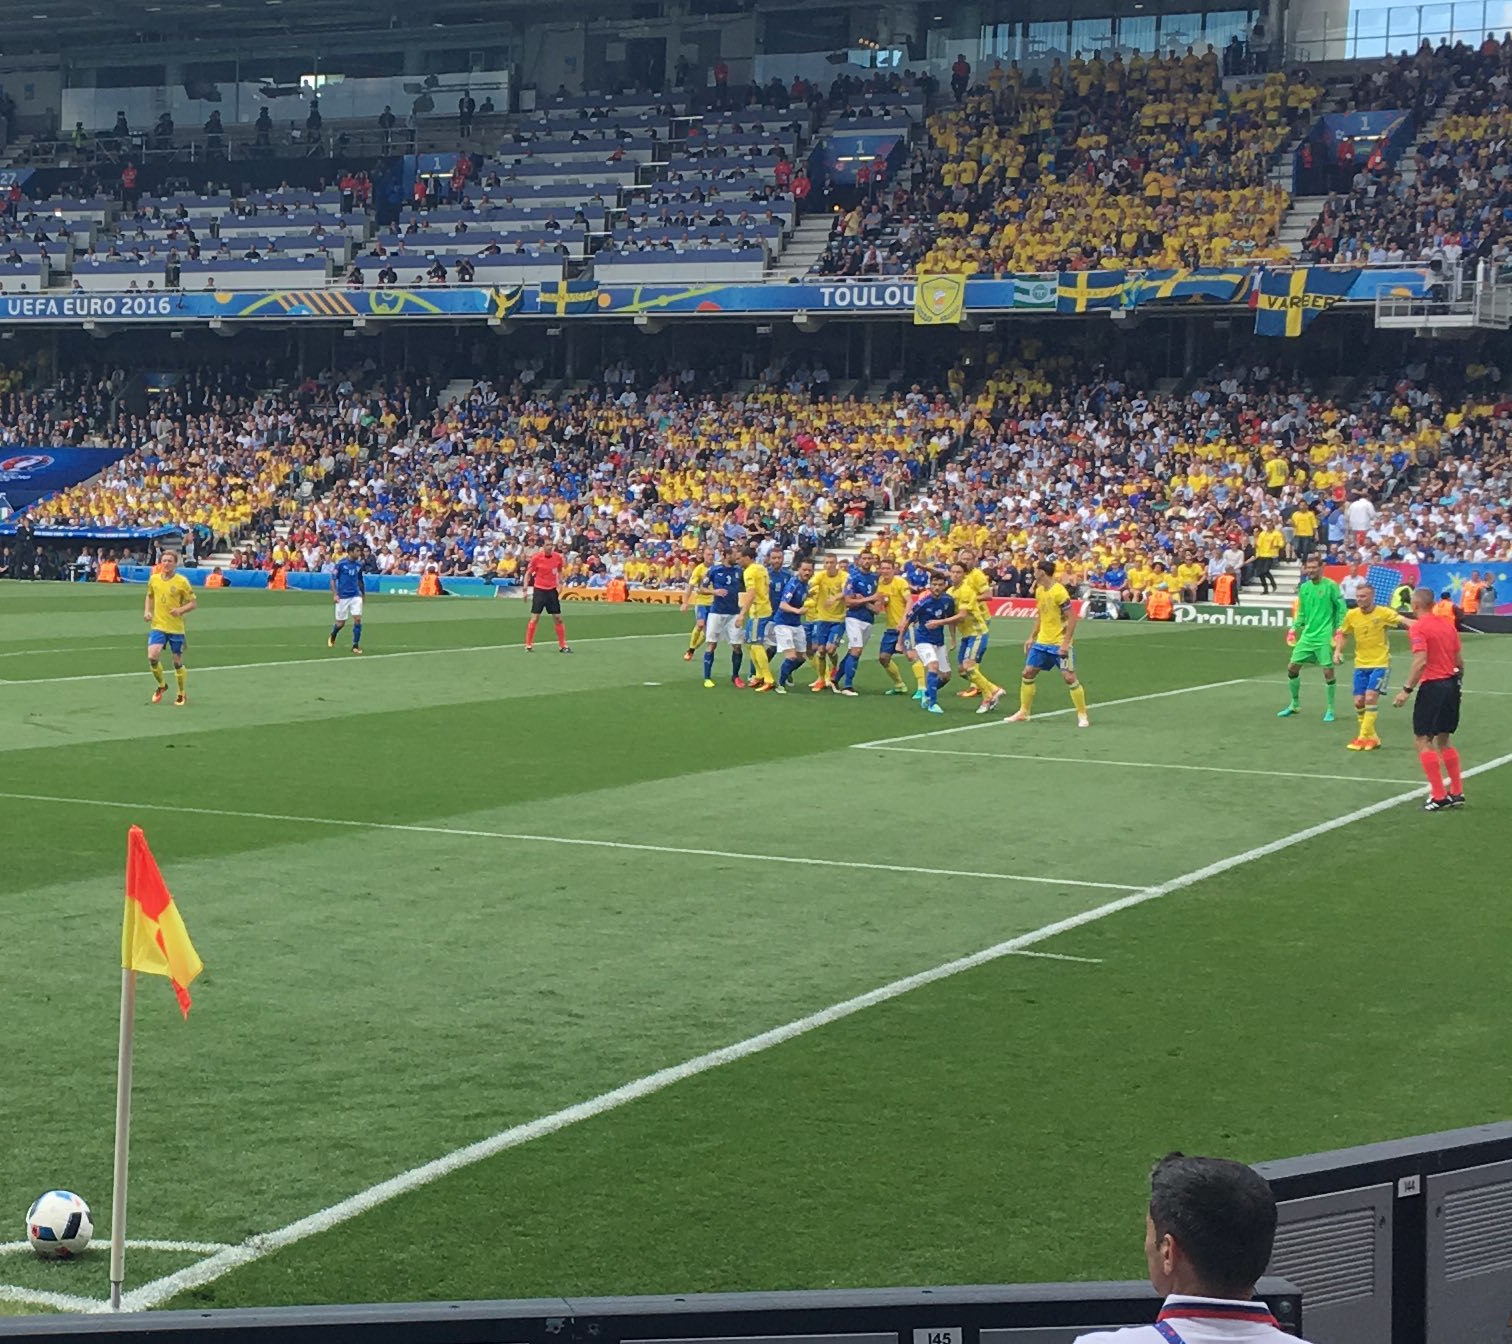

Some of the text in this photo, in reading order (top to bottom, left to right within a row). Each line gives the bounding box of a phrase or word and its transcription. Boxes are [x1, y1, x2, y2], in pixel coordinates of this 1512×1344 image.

[0, 172, 17, 185] 27
[820, 286, 917, 307] TOULOU
[1268, 295, 1346, 310] VARBER
[8, 297, 171, 316] UEFA EURO 2016
